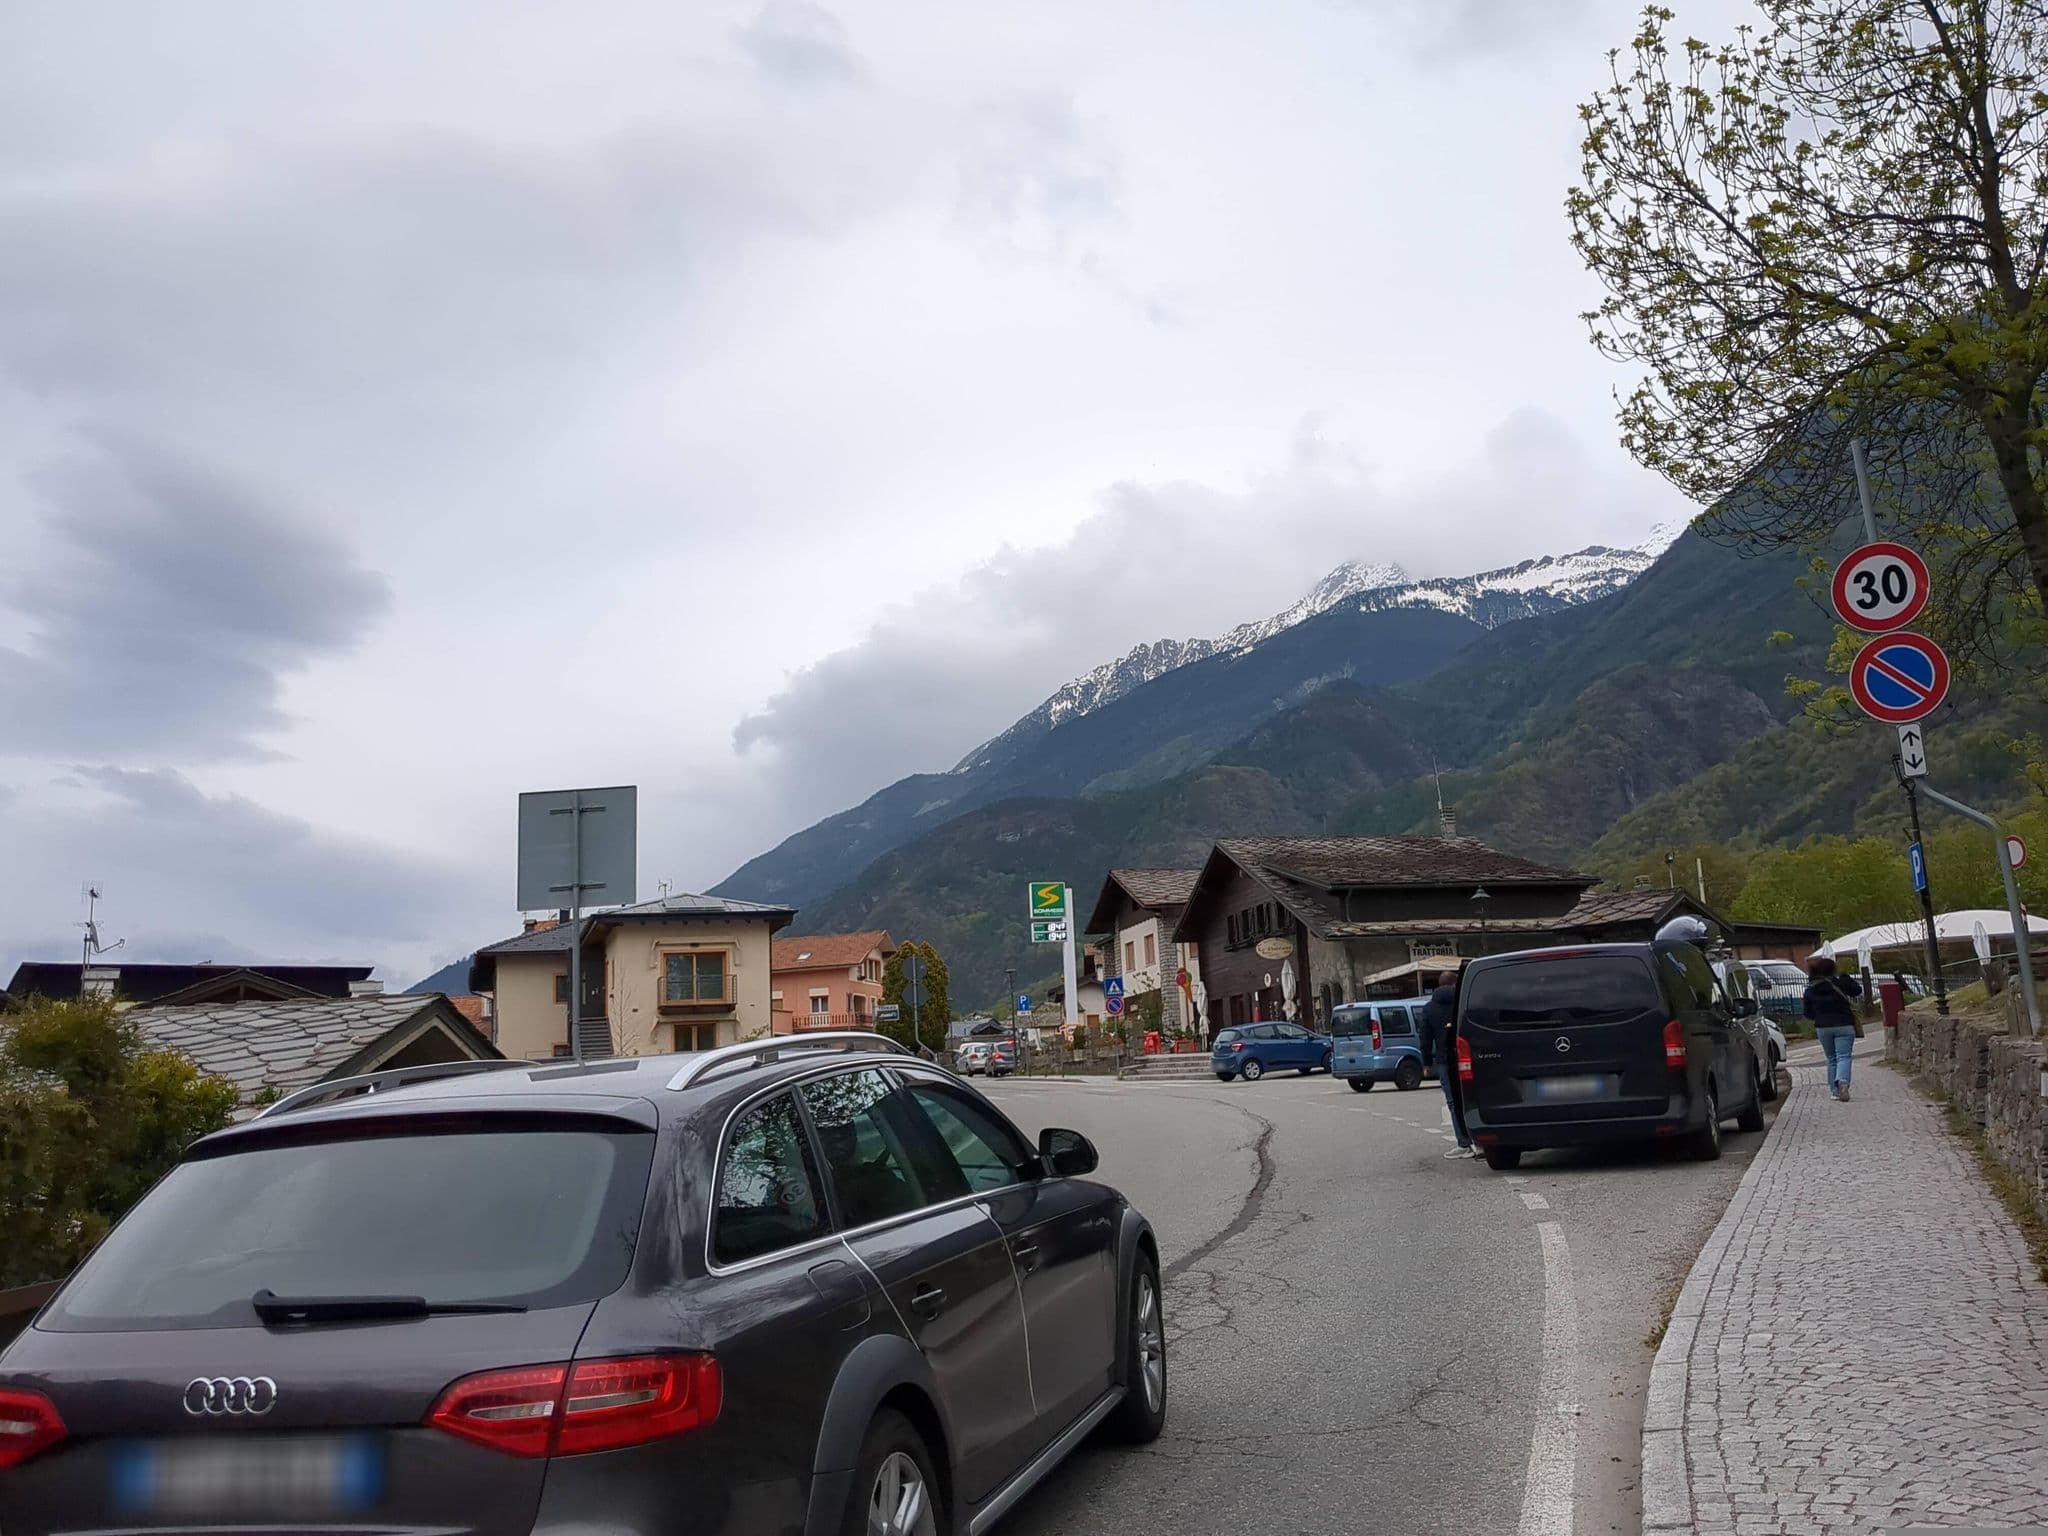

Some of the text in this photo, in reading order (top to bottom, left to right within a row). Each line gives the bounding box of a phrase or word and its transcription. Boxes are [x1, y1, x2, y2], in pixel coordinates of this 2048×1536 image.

[1852, 563, 1909, 610] 30
[1911, 849, 1921, 887] P
[1413, 947, 1453, 957] TRATTORIA
[1020, 995, 1027, 1005] P
